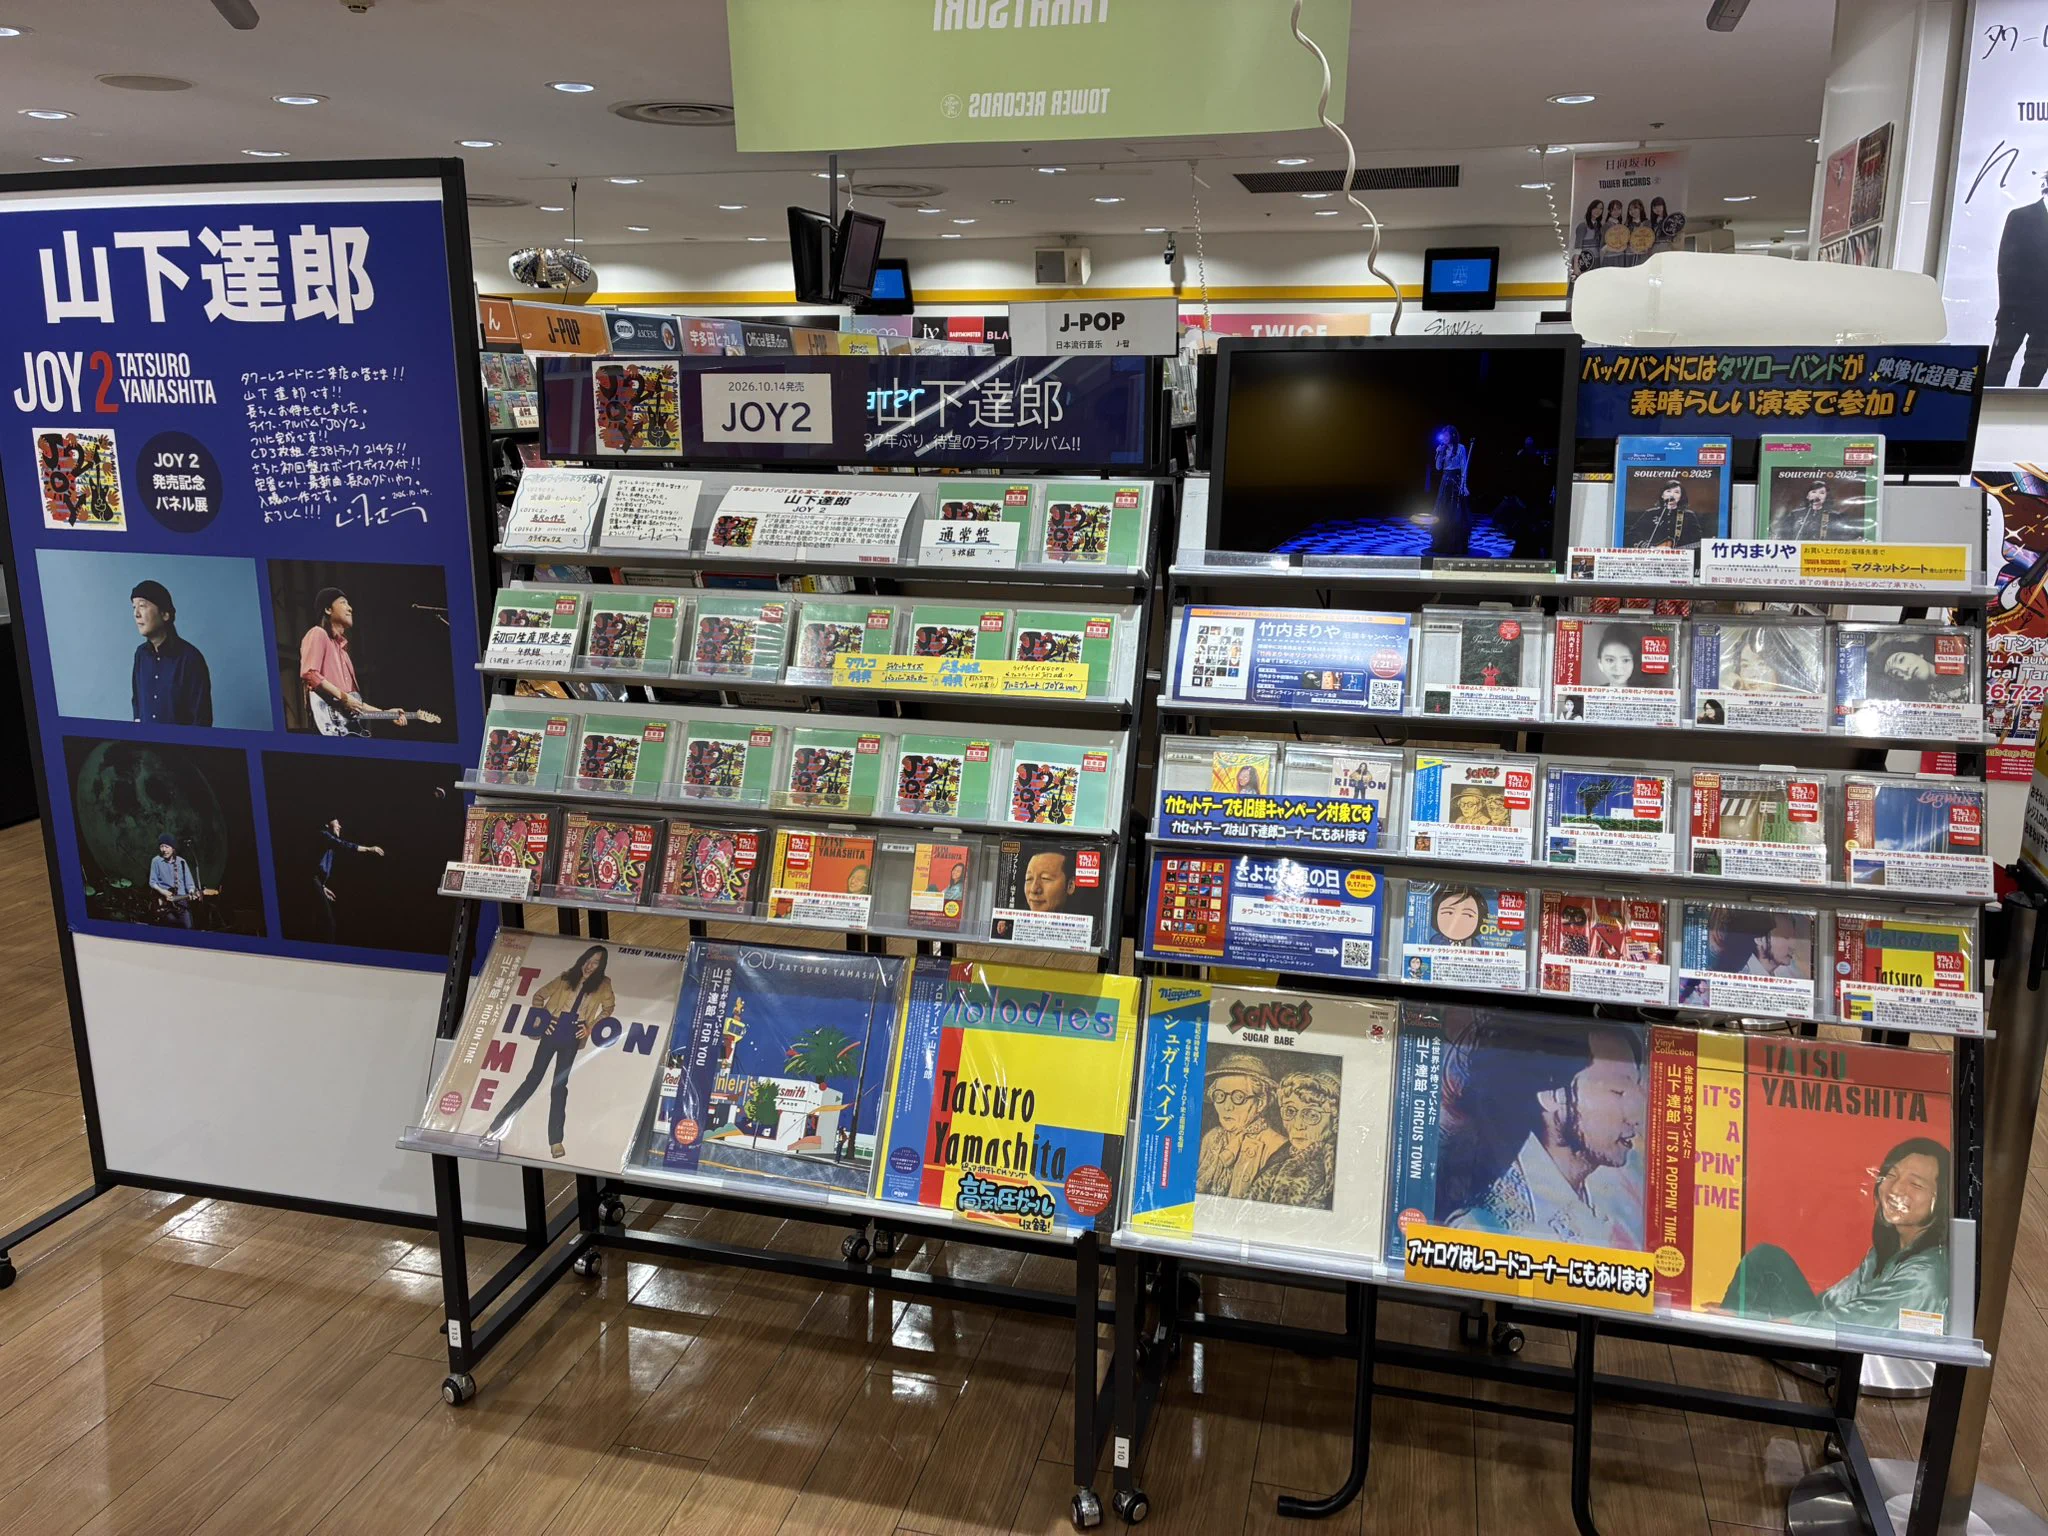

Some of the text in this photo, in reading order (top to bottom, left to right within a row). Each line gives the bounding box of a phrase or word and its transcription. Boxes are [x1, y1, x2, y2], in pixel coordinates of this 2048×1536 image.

[1599, 177, 1651, 189] TOWER RECORDS
[38, 224, 375, 324] 山下達郎
[487, 316, 500, 331] ん
[546, 316, 581, 346] J-POP
[1059, 313, 1125, 332] J-POP
[116, 352, 190, 378] TATSURO
[1581, 354, 1866, 383] バックバンドにはタツローバンドが
[1876, 357, 1976, 393] 映像化超貴重
[13, 350, 119, 414] JOY 2
[119, 378, 217, 405] YAMASHITA
[728, 381, 805, 393] 2026.10.14発売
[876, 377, 1064, 431] 山下達郎
[1630, 389, 1916, 417] 素晴らしい演奏で参加！
[722, 402, 812, 432] JOY2
[153, 451, 200, 469] JOY 2
[152, 473, 206, 492] 発売記念
[1633, 470, 1712, 480] souvenir 2025
[1778, 470, 1857, 480] souvenir 2025
[156, 495, 209, 514] パネル展
[784, 494, 852, 507] 山下達郎
[939, 526, 990, 543] 通常盤
[1712, 542, 1797, 560] 竹内まりや
[1803, 547, 1885, 556] お買い上げのお客様先着で
[1851, 562, 1928, 574] マグネットシート
[492, 630, 572, 645] 初回生産限定盤
[1259, 621, 1341, 639] 竹内まりや
[845, 657, 878, 669] タワレコ
[2007, 656, 2048, 665] ALBUM
[1465, 766, 1500, 781] SONGS
[1164, 794, 1375, 824] カセットテープも旧譜キャンペーン対象です
[1171, 821, 1368, 843] カセットテープは山下達郎コーナーにもあります
[819, 847, 866, 860] YAMASHITA
[1171, 933, 1207, 944] TATSURO
[618, 946, 642, 957] TATSU
[779, 964, 828, 975] TATSURO
[1874, 966, 1923, 989] Tatsuro
[1159, 988, 1202, 1001] Niagara
[463, 955, 513, 1064] 山下達郎 RIDE ON TIME
[695, 967, 724, 1067] 山下達郎 FOR YOU
[712, 967, 733, 1046] 全世界が待っていた!!
[930, 984, 945, 1036] メロディーズ
[1226, 1000, 1313, 1035] SONGS
[590, 1017, 660, 1055] ON
[1242, 1031, 1295, 1047] SUGAR BABE
[1654, 1038, 1676, 1048] Vinyl
[1654, 1046, 1695, 1058] Collection
[1764, 1044, 1847, 1081] TATSU
[1428, 1035, 1441, 1126] 全世界が待っていた!!
[940, 1070, 1036, 1123] Tatsuro
[1410, 1035, 1430, 1180] 山下達郎 CIRCUS TOWN
[1761, 1078, 1928, 1123] YAMASHITA
[1683, 1065, 1695, 1159] 全世界が待っていた!!
[1726, 1120, 1741, 1143] A
[934, 1121, 1067, 1182] Yamashita
[1664, 1063, 1682, 1244] 山下達郎 IT'S A POPPIN' TIME
[958, 1172, 1055, 1216] 高気圧ガール
[1018, 1218, 1052, 1233] 収録!
[1406, 1238, 1651, 1296] アナログはレコードコーナーにもあります
